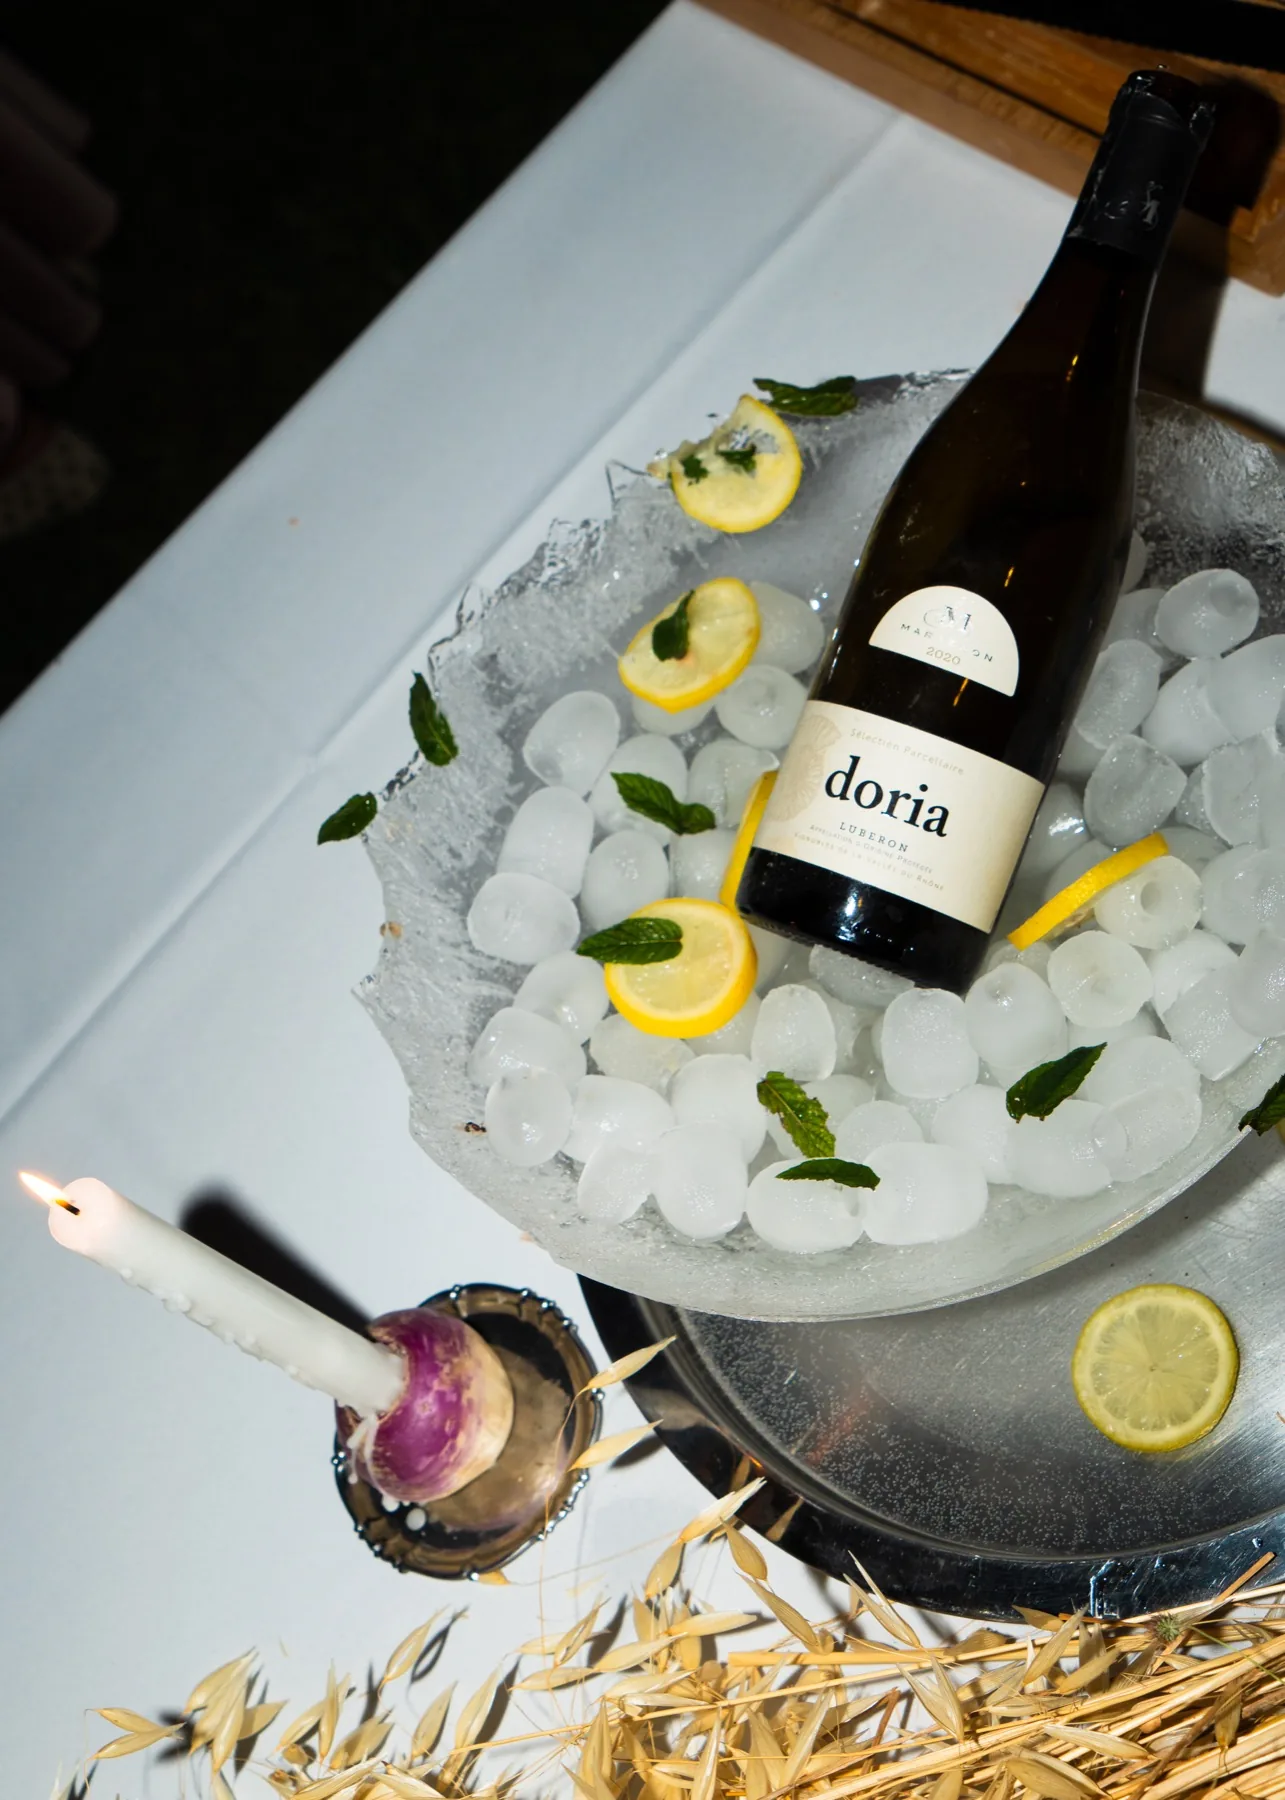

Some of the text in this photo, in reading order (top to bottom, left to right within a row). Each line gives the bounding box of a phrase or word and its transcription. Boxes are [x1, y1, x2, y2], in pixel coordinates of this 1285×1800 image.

[901, 623, 994, 662] MARON
[926, 646, 961, 665] 2020
[903, 745, 964, 775] Parcellaire
[825, 755, 947, 838] doria
[839, 821, 909, 852] LUBERON
